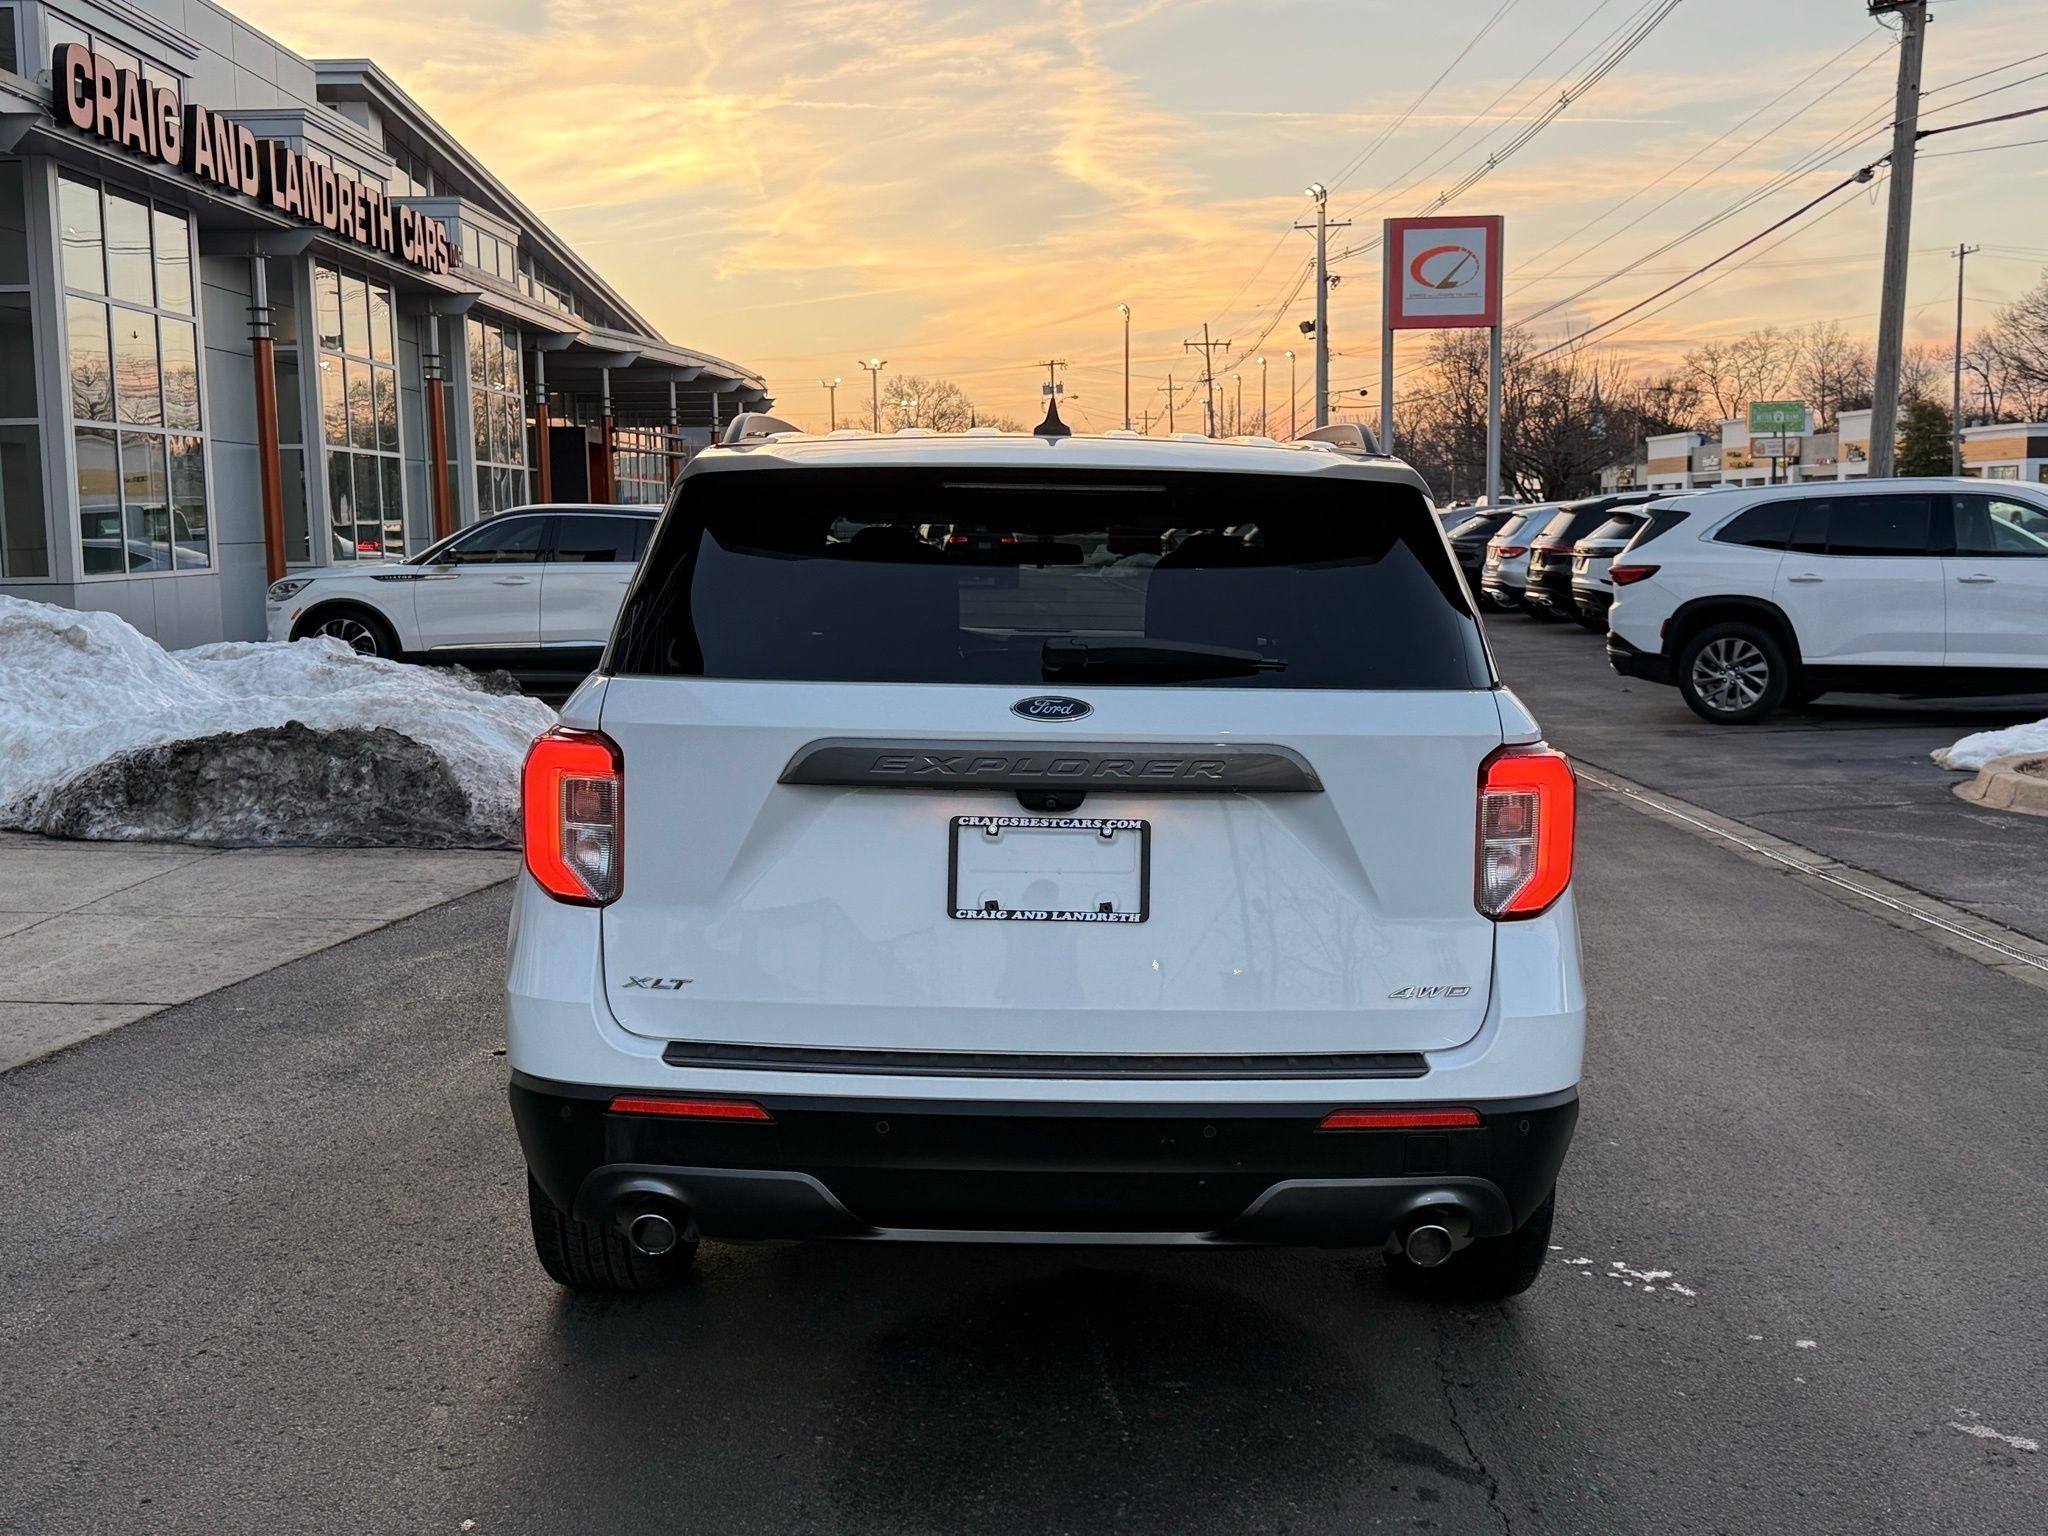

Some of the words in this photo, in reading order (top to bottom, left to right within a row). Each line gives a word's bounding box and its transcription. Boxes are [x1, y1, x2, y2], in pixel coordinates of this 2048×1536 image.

[64, 42, 181, 166] CRAIG
[194, 103, 260, 198] AND
[269, 139, 395, 254] LANDRETH
[400, 204, 450, 275] CARS
[1029, 699, 1074, 715] Ford
[869, 754, 1227, 780] EXPLORER
[957, 816, 1142, 830] CRAIGSBESTCARS.COM
[955, 909, 1008, 920] CRAIG
[1011, 910, 1047, 921] AND
[1052, 911, 1141, 923] LANDRETH
[622, 975, 694, 990] XLT
[1388, 984, 1471, 999] 4WD
